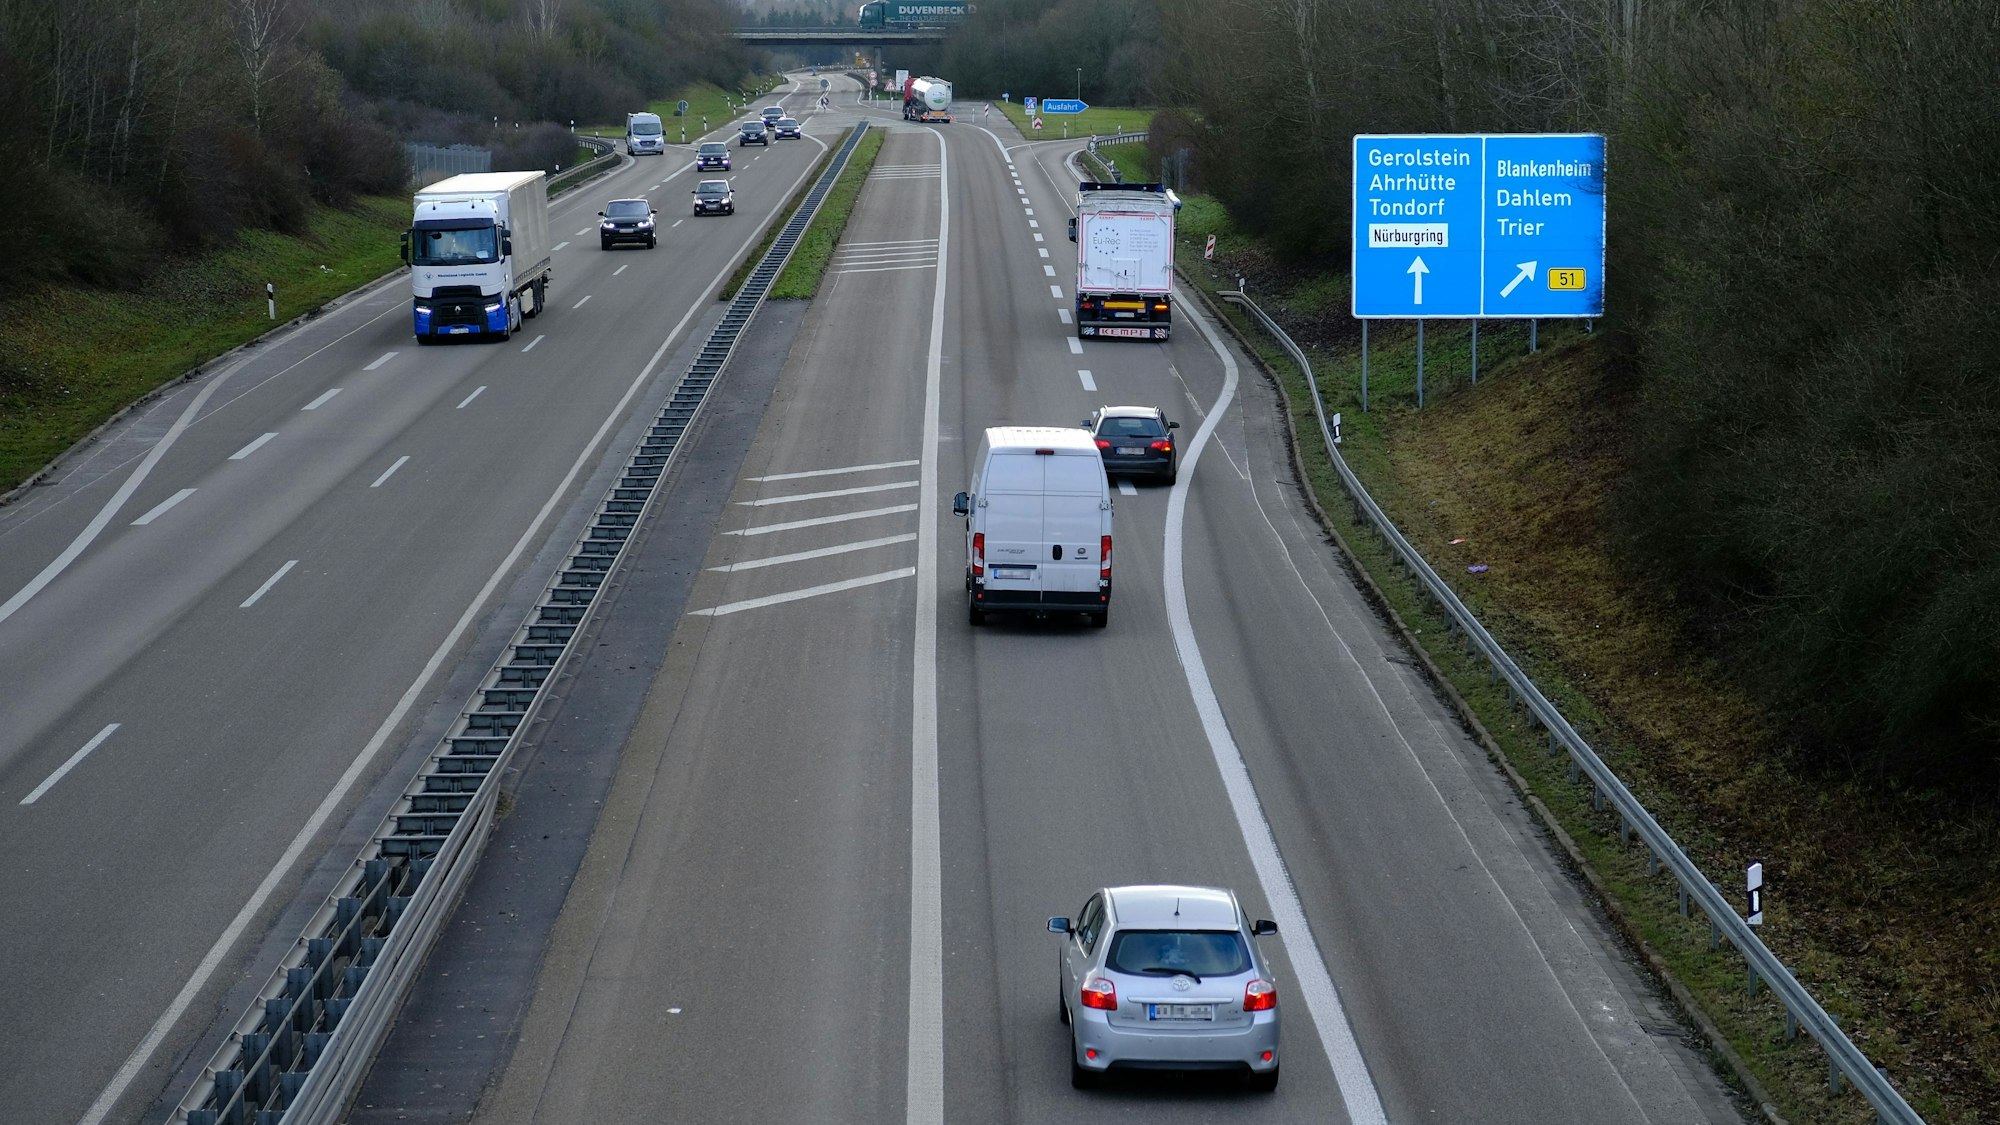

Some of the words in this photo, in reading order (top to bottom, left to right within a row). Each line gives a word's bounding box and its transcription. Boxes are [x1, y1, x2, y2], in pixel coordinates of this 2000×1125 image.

[898, 5, 965, 15] DUVENBECK
[1047, 103, 1078, 111] Ausfahrt
[1368, 149, 1471, 167] Gerolstein
[1497, 160, 1592, 177] Blankenheim
[1368, 174, 1456, 191] Ahrhütte
[1497, 189, 1572, 206] Dahlem
[1368, 198, 1446, 216] Tondorf
[1497, 218, 1545, 236] Trier
[1093, 236, 1121, 245] Eu-Rec
[1374, 228, 1444, 246] Nürburgring
[1559, 272, 1576, 286] 51
[1101, 328, 1149, 336] KEMPF
